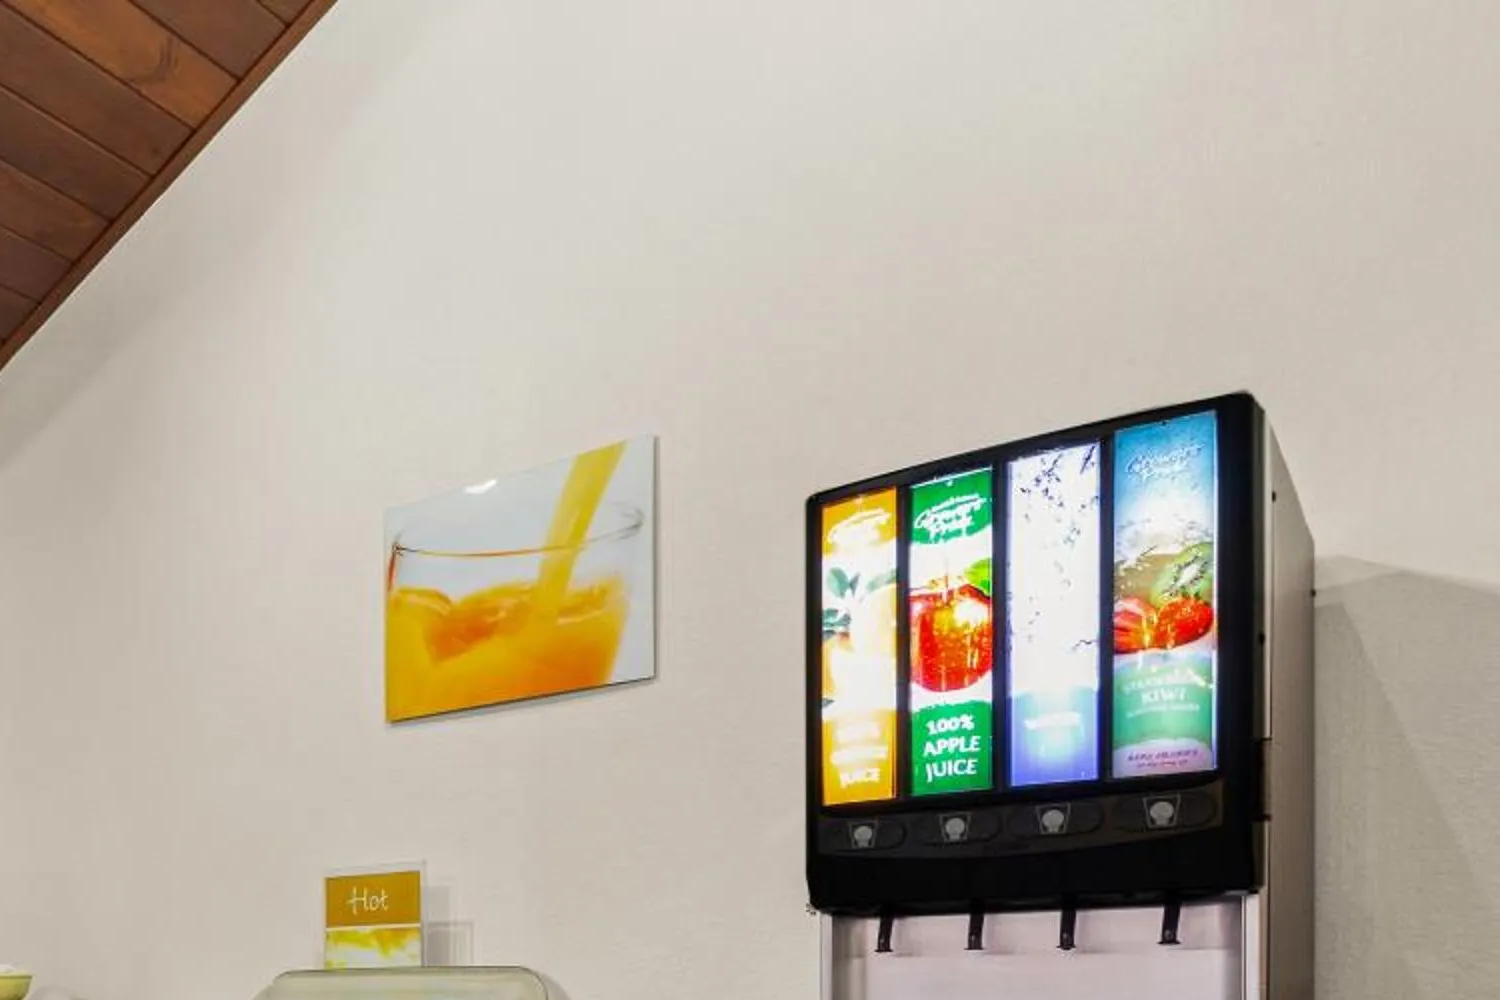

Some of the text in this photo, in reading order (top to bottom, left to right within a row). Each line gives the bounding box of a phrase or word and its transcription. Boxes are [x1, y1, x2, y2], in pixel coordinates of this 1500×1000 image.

[925, 713, 975, 735] 100%
[923, 735, 981, 757] APPLE
[925, 759, 978, 782] JUICE
[346, 885, 389, 915] Hot
